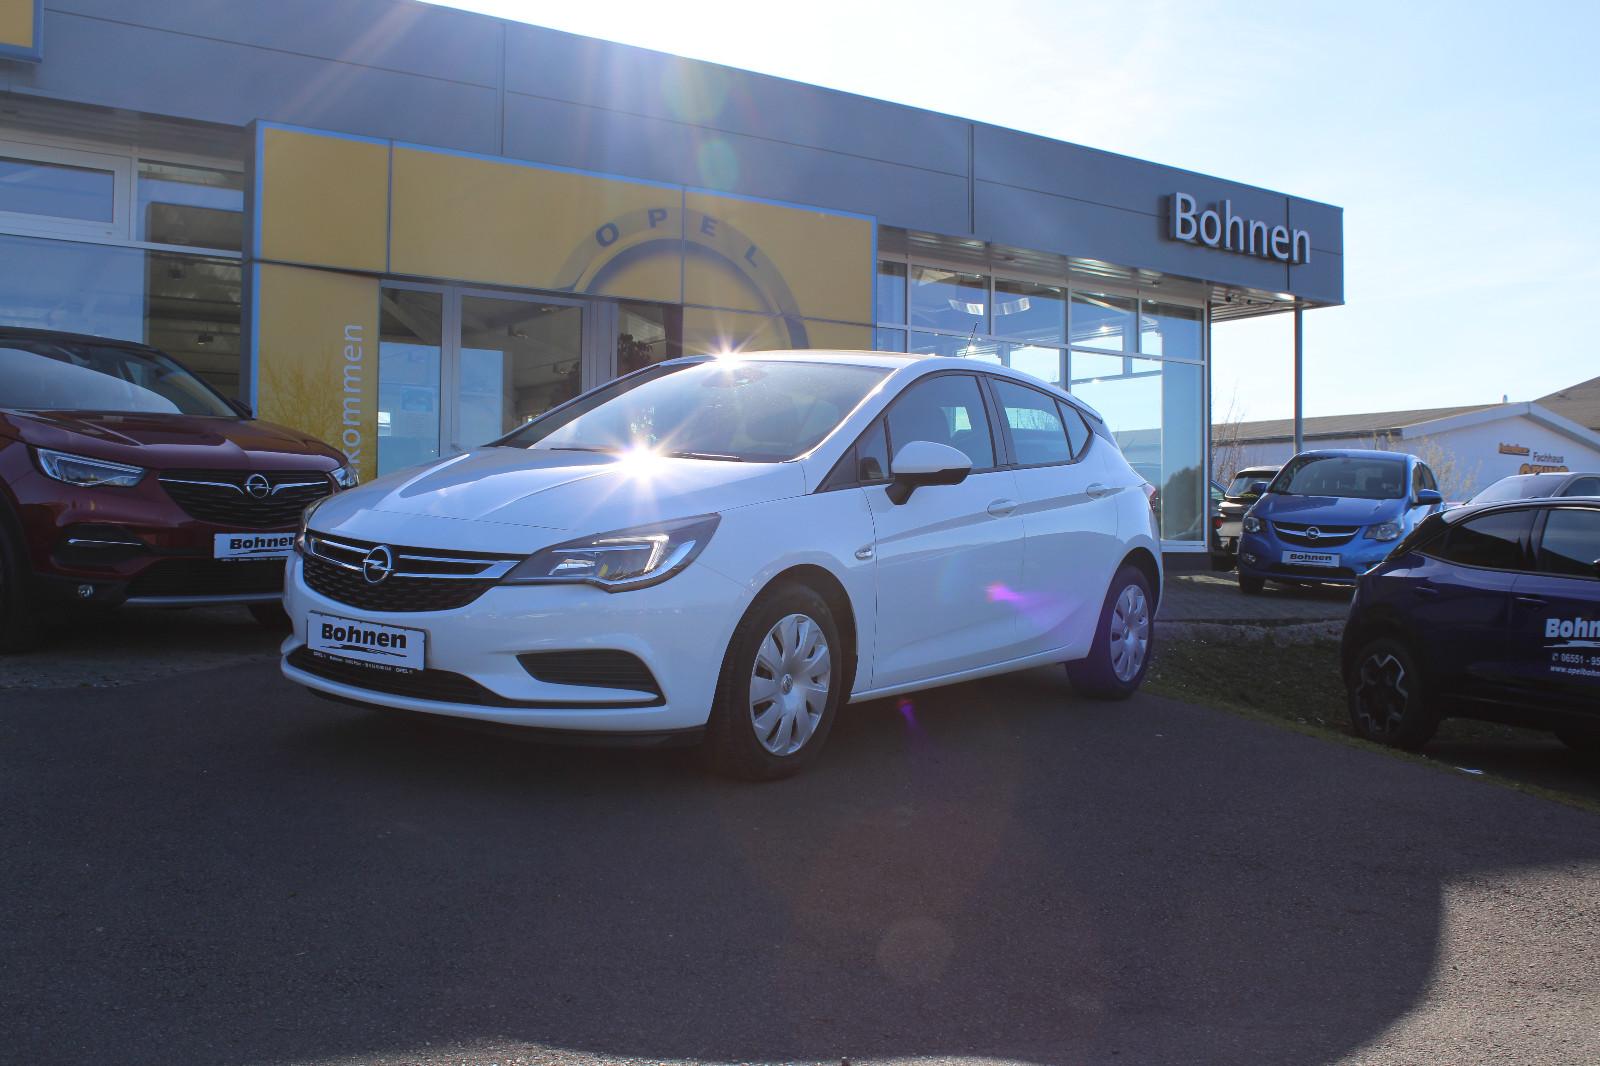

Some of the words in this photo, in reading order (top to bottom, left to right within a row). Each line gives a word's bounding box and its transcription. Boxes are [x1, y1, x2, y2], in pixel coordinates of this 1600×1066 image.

[595, 207, 758, 269] OPEL
[1175, 191, 1311, 264] Bohnen
[1290, 553, 1332, 561] Bohnen
[321, 623, 407, 649] Bohnen
